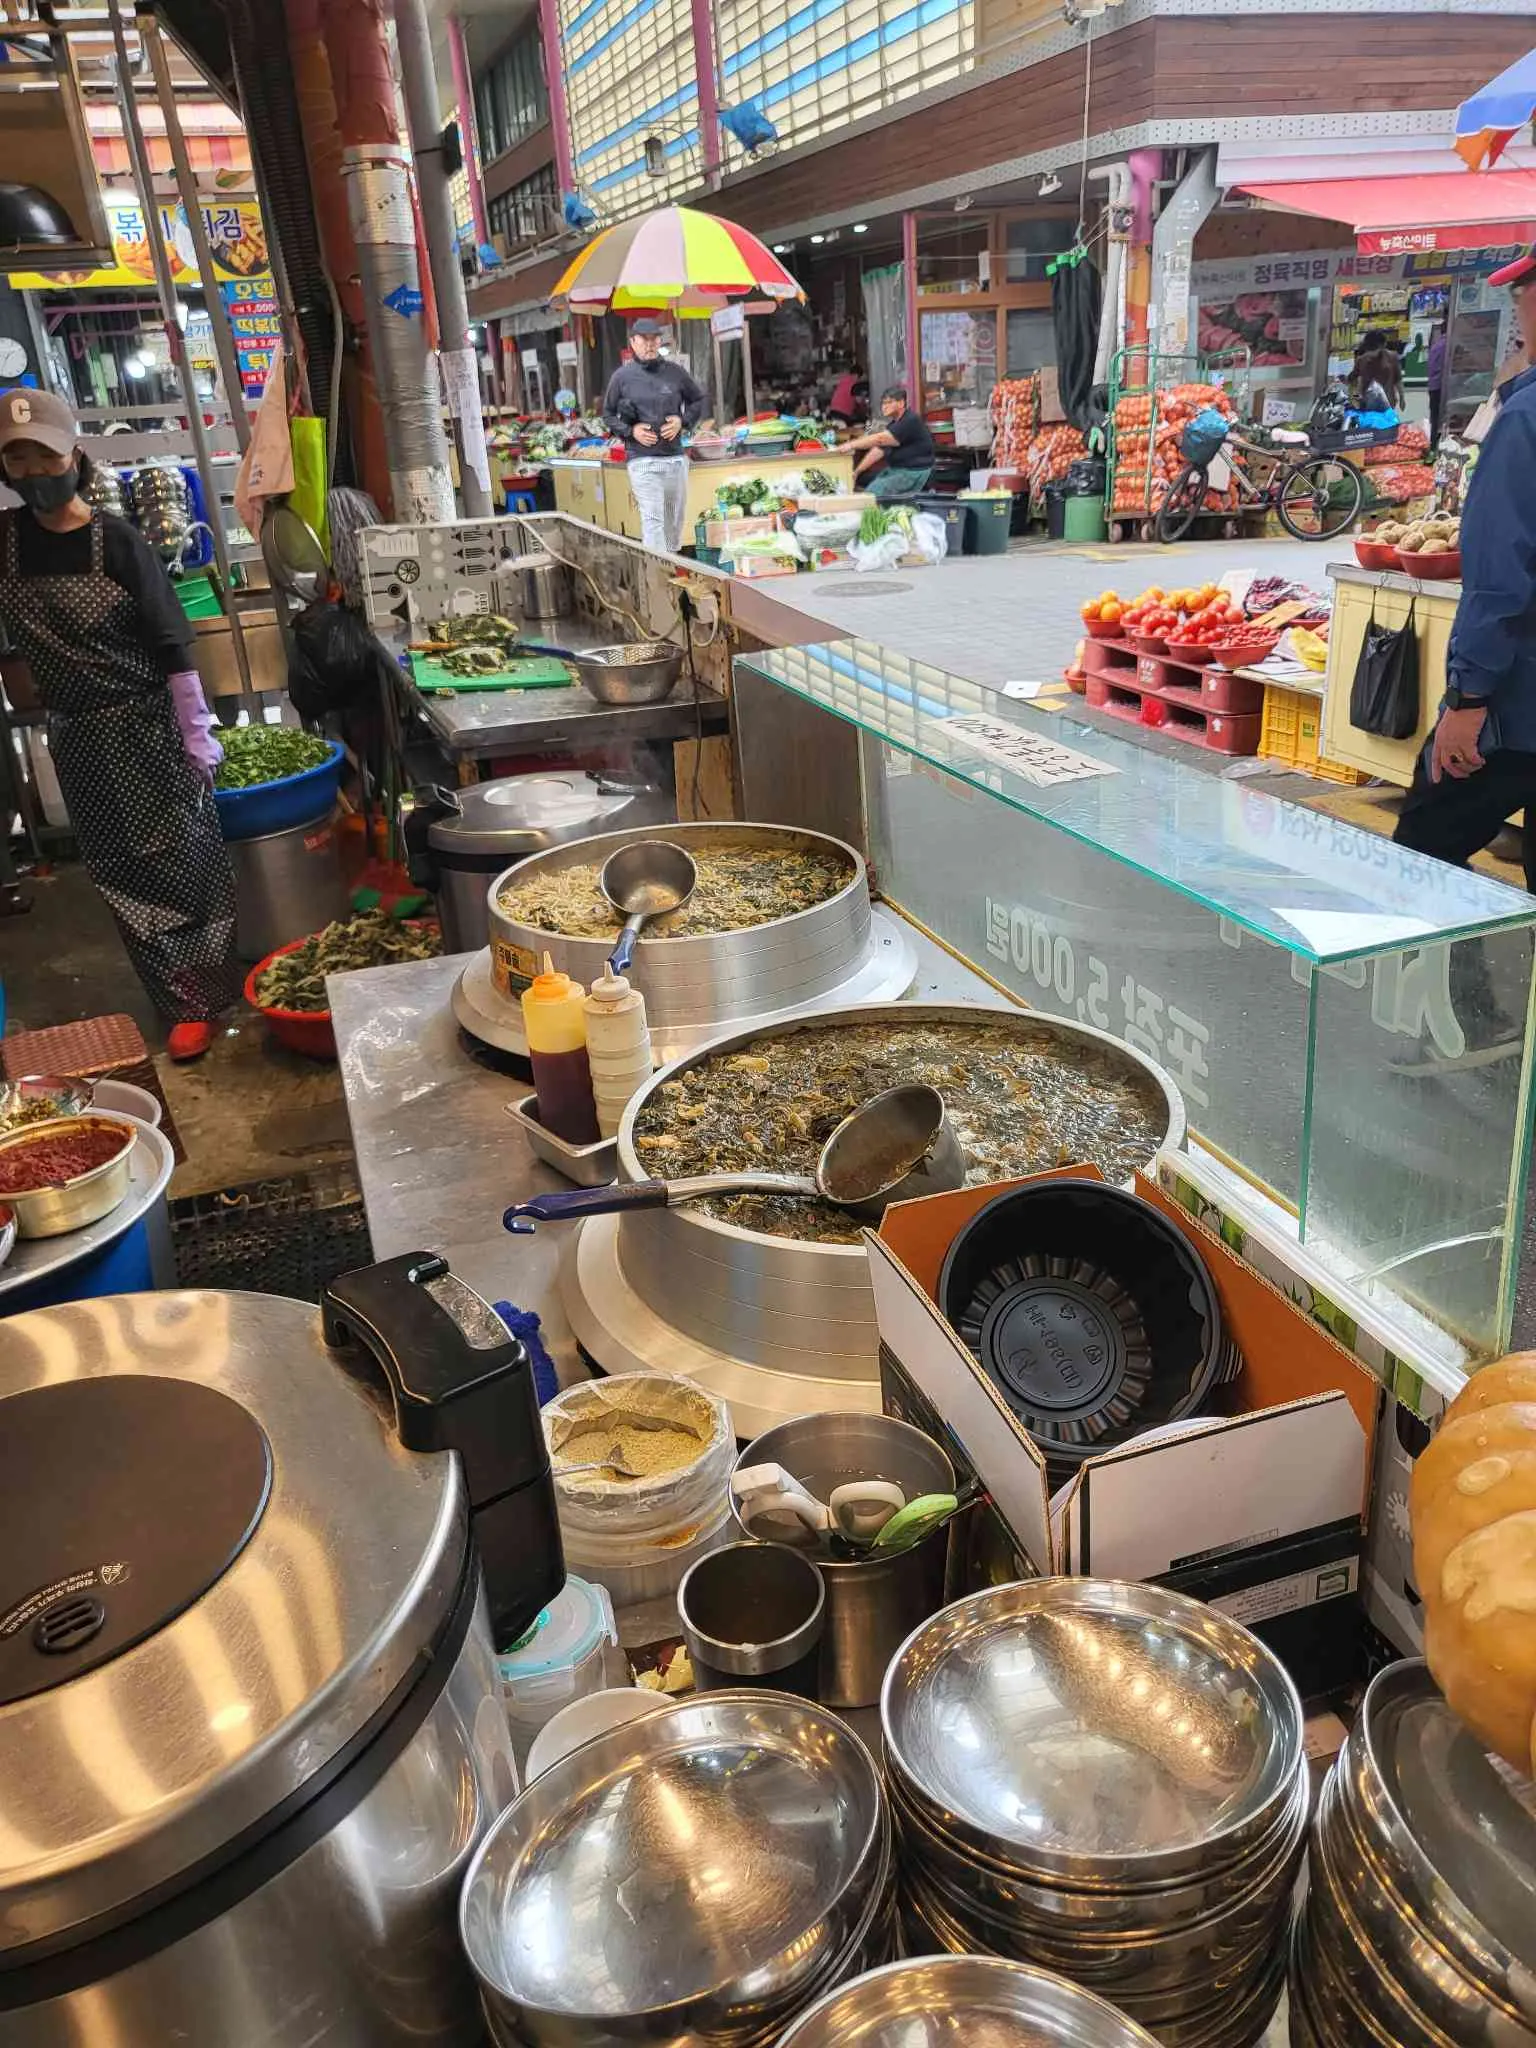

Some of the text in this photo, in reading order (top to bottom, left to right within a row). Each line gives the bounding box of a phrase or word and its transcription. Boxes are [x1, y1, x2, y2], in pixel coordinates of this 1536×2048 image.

[1254, 259, 1329, 284] 정육직영
[1335, 256, 1394, 277] 새단장
[10, 398, 31, 424] C
